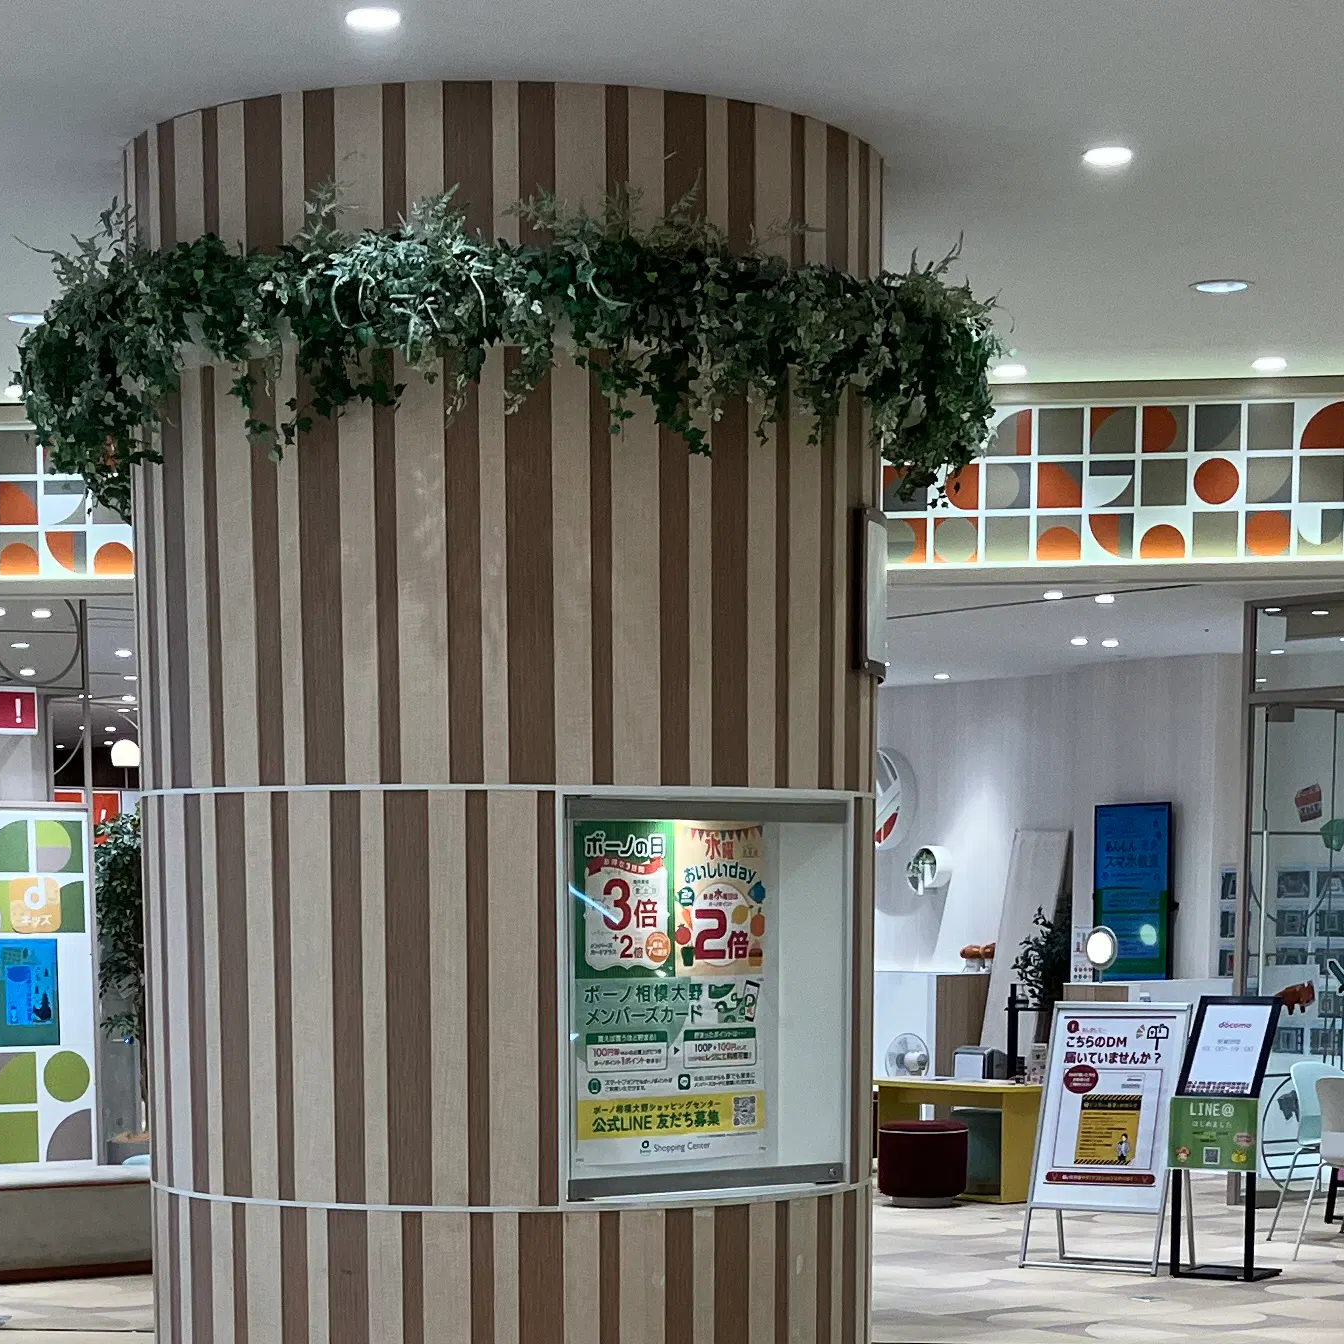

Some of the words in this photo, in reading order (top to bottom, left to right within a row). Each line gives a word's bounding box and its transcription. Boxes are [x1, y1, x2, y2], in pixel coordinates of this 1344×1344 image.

[586, 831, 664, 857] ボーノの日
[704, 832, 735, 860] 水曜
[684, 862, 757, 884] おいしいday
[20, 914, 53, 926] キッズ
[584, 984, 703, 1003] ボーノ相模大野
[585, 1004, 703, 1026] メンバーズカード
[1218, 1021, 1252, 1029] docomo
[1066, 1036, 1127, 1048] こちらのDM
[1064, 1051, 1162, 1064] 届いていませんか？
[593, 1101, 722, 1114] ボーノ相模大野ショッピングセンター
[1189, 1103, 1235, 1117] LINE@
[592, 1115, 652, 1133] 公式LINE
[656, 1110, 721, 1129] 友だち募集
[654, 1143, 685, 1153] Shopping
[687, 1142, 711, 1150] Center
